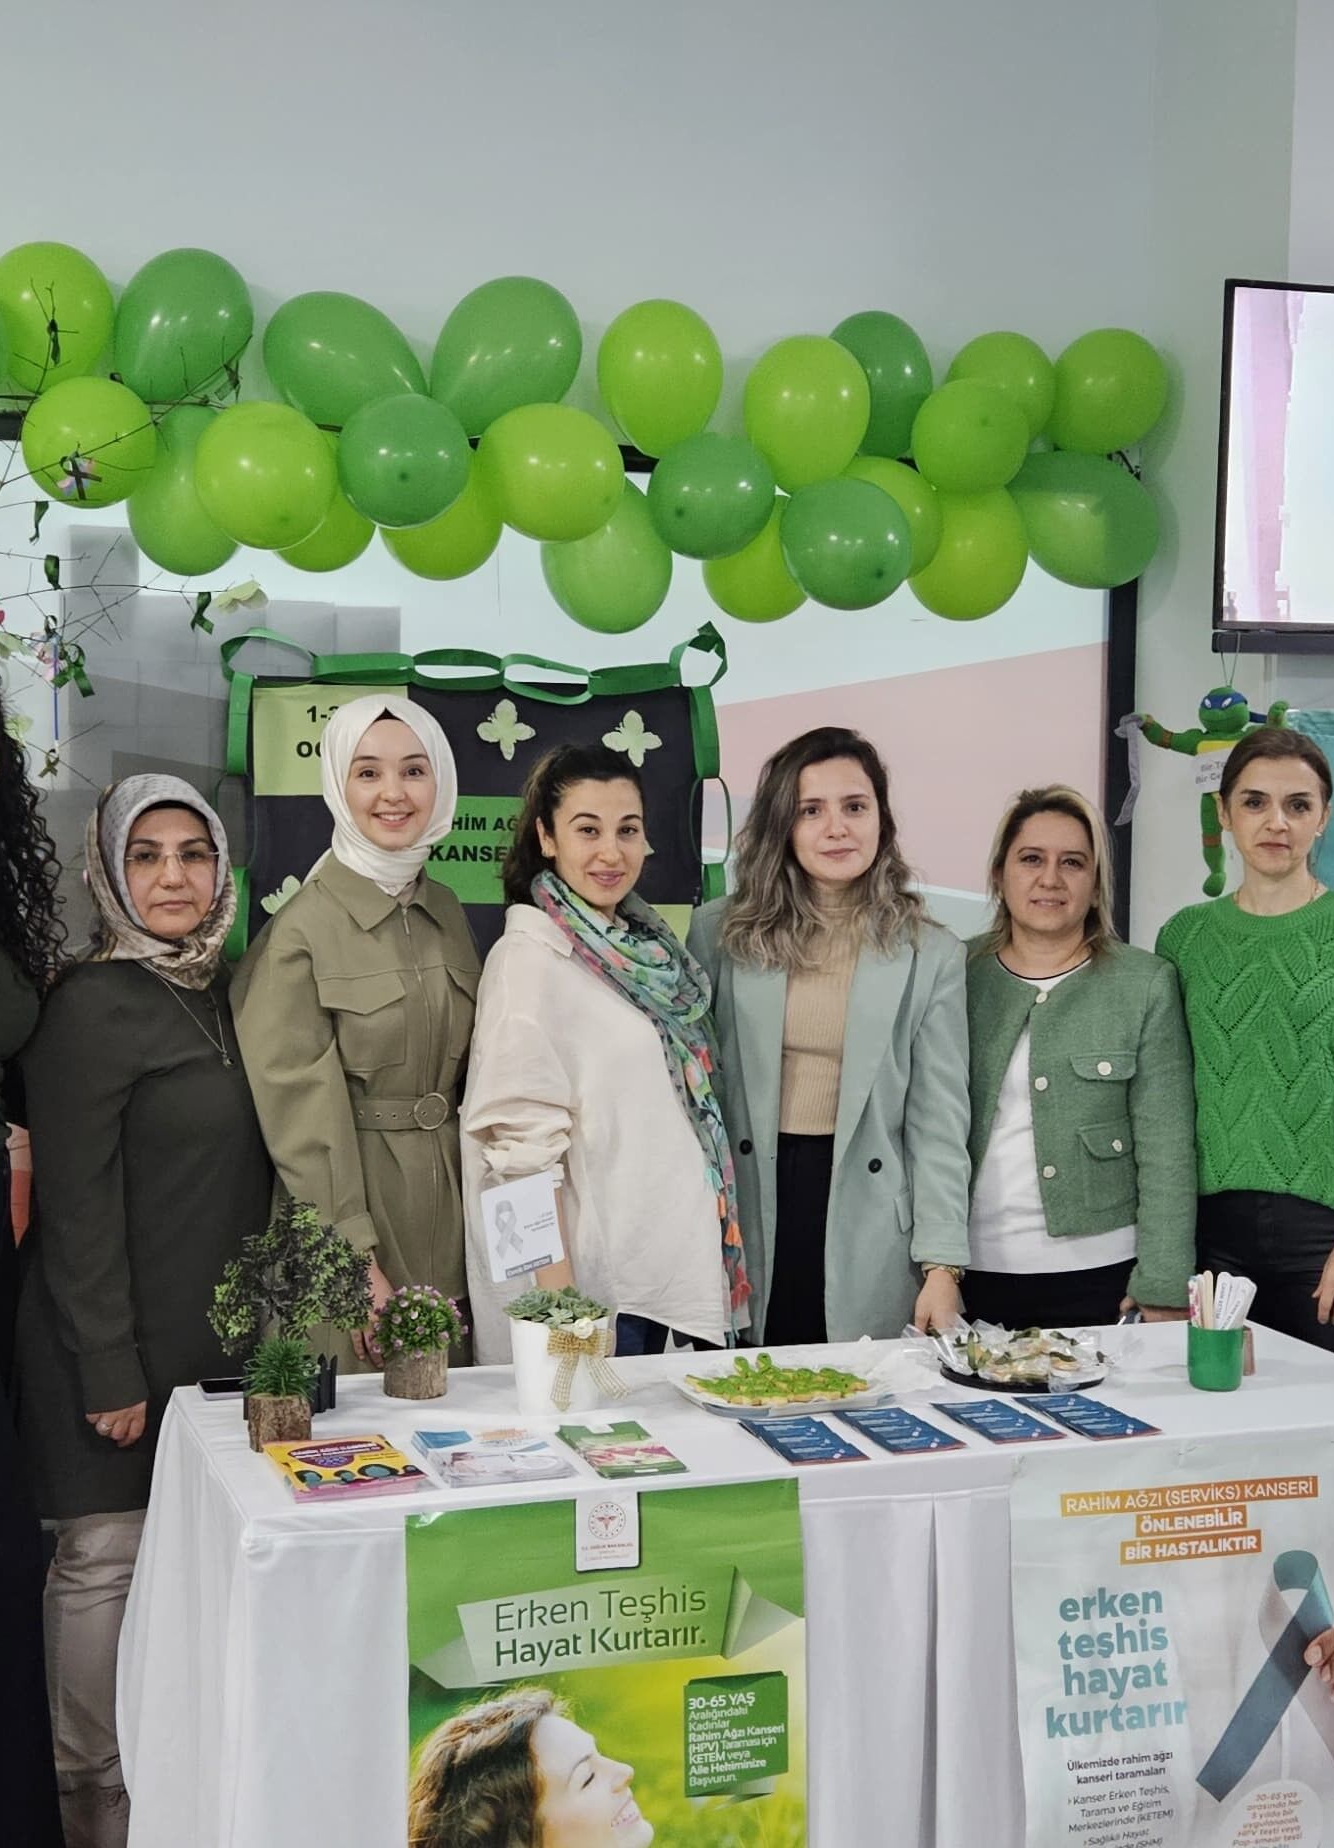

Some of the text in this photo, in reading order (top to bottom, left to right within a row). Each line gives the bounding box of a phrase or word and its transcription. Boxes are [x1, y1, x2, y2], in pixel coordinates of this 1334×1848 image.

[1067, 1481, 1314, 1513] RAHİM AĞZI (SERVİKS) KANSERİ
[1140, 1507, 1243, 1533] ÖNLENEBİLİR
[1125, 1535, 1258, 1560] BİR HASTALIKTIR
[496, 1585, 706, 1632] Erken Teşhis
[1059, 1587, 1163, 1622] erken
[496, 1626, 706, 1667] Hayat Kurtarır.
[1058, 1618, 1168, 1660] teşhis
[1063, 1658, 1168, 1700] hayat
[688, 1692, 755, 1710] 30-65 YAŞ
[689, 1706, 748, 1720] Aralığındaki
[1046, 1700, 1188, 1739] kurtarır
[689, 1720, 730, 1732] Kadınlar
[689, 1723, 785, 1742] Rahim Ağzı Kanseri
[689, 1741, 719, 1754] (HPV)
[689, 1750, 750, 1764] KETEM veya
[689, 1759, 766, 1776] Aile Hekiminize
[1067, 1750, 1173, 1771] Ülkemizde rahim ağzı
[1077, 1767, 1166, 1784] kanseri taramaları
[1080, 1806, 1116, 1818] Tarama
